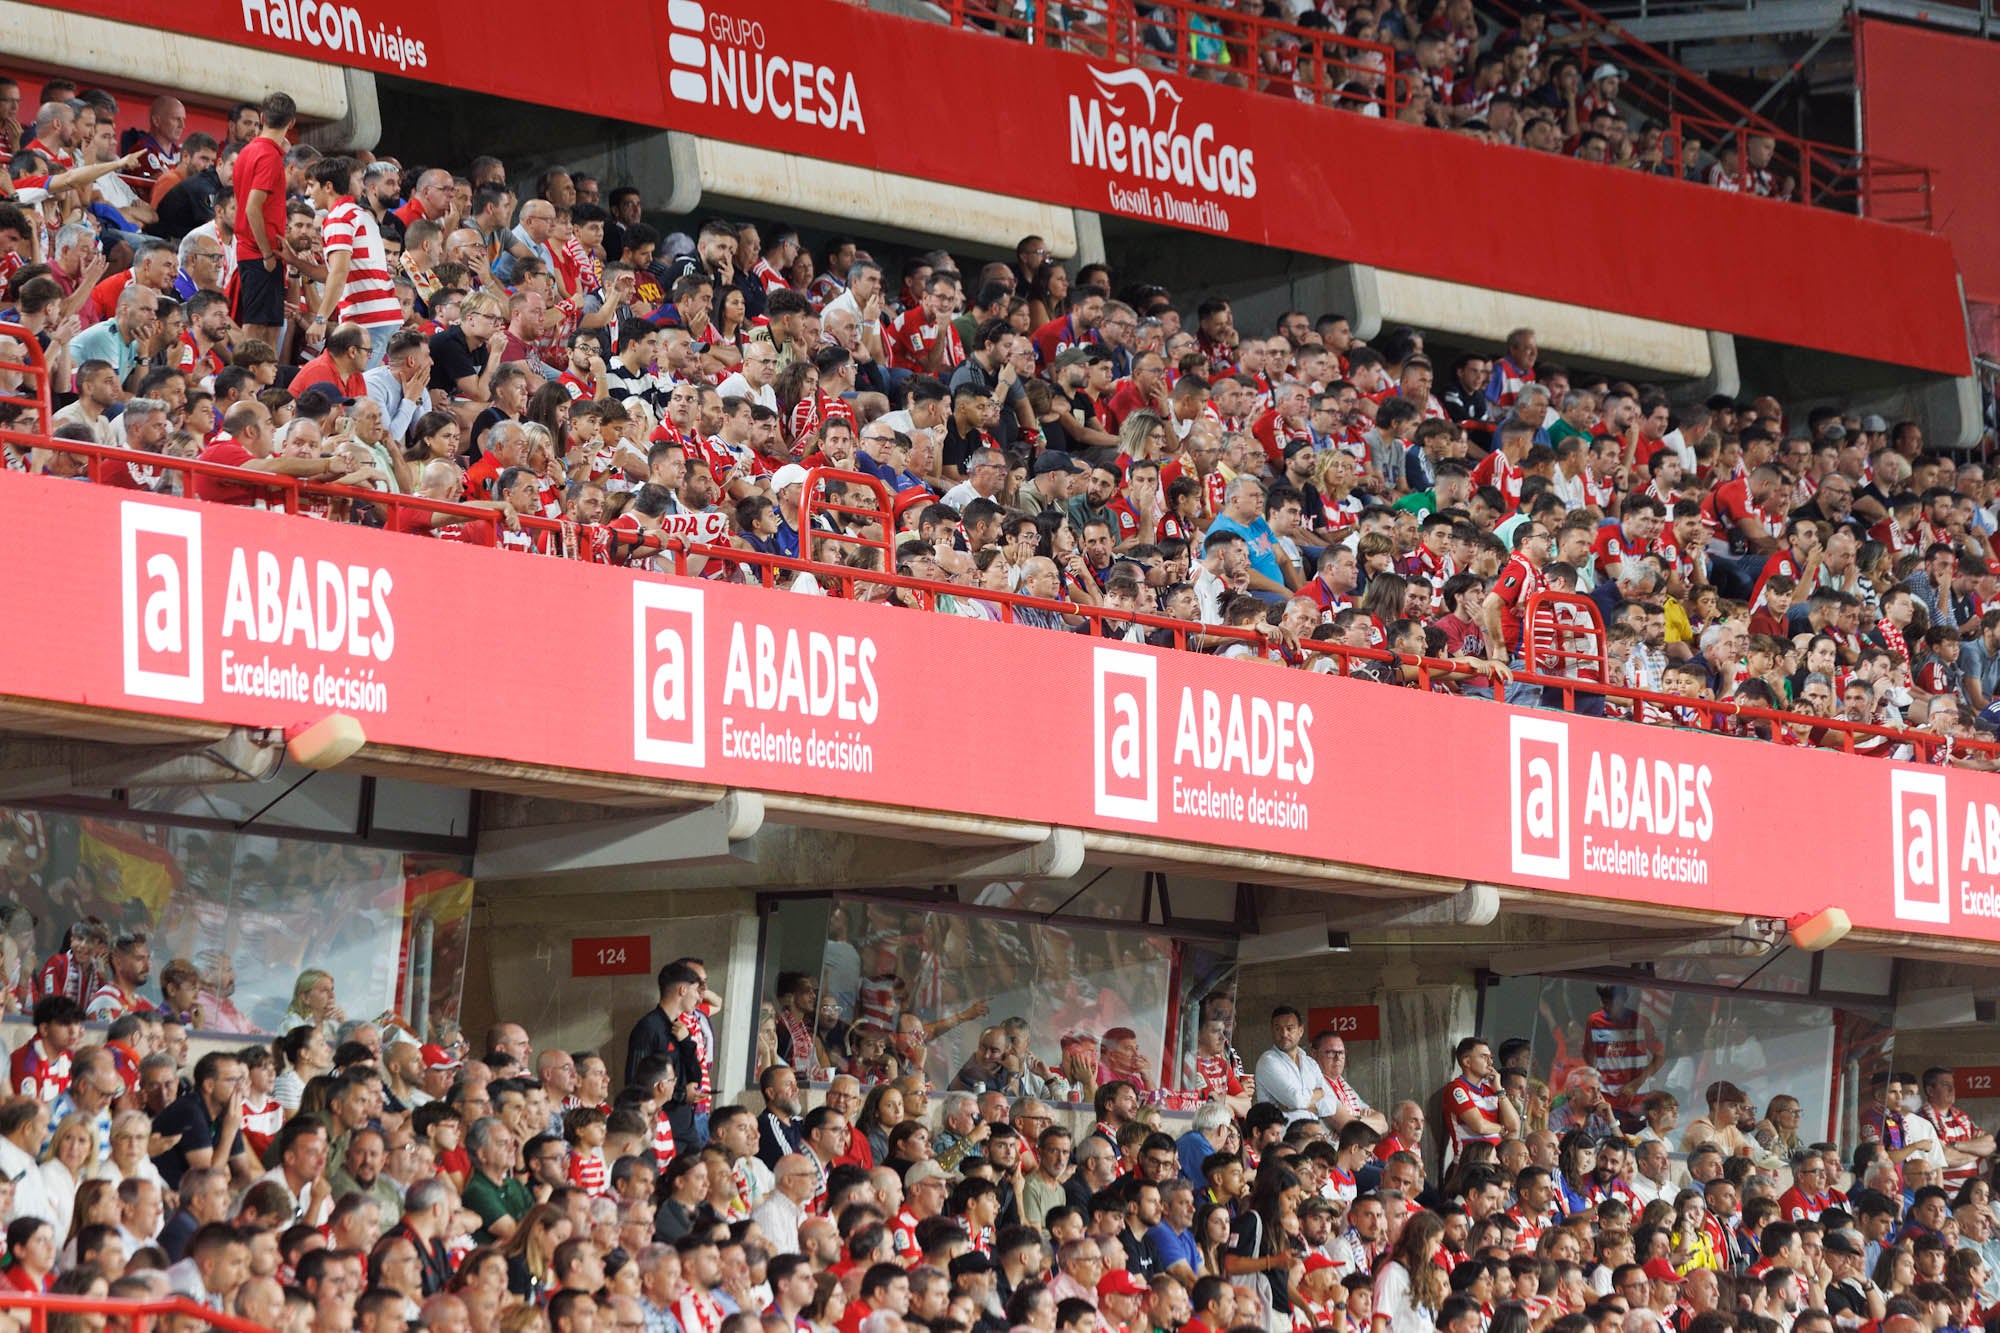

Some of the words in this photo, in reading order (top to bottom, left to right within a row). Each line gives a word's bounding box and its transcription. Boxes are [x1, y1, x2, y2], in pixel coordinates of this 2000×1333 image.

[368, 22, 427, 71] viajes
[709, 12, 765, 50] GRUPO
[710, 43, 866, 135] NUCESA
[1069, 94, 1257, 199] MensaGas
[1108, 180, 1152, 217] Gasoil
[1153, 195, 1163, 218] a
[1163, 191, 1229, 232] Domicilio
[222, 547, 394, 662] ABADES
[221, 649, 309, 703] Excelente
[313, 664, 387, 713] decisión
[723, 621, 879, 725] ABADES
[722, 717, 802, 765] Excelente
[806, 728, 873, 774] decisión
[1174, 686, 1315, 785] ABADES
[1173, 775, 1244, 823] Excelente
[1248, 787, 1308, 831] decisión
[1584, 751, 1714, 842] ABADES
[1583, 835, 1649, 879] Excelente
[1652, 844, 1708, 885] decisión
[597, 948, 626, 964] 124
[1331, 1016, 1357, 1031] 123
[1967, 1076, 1992, 1088] 122
